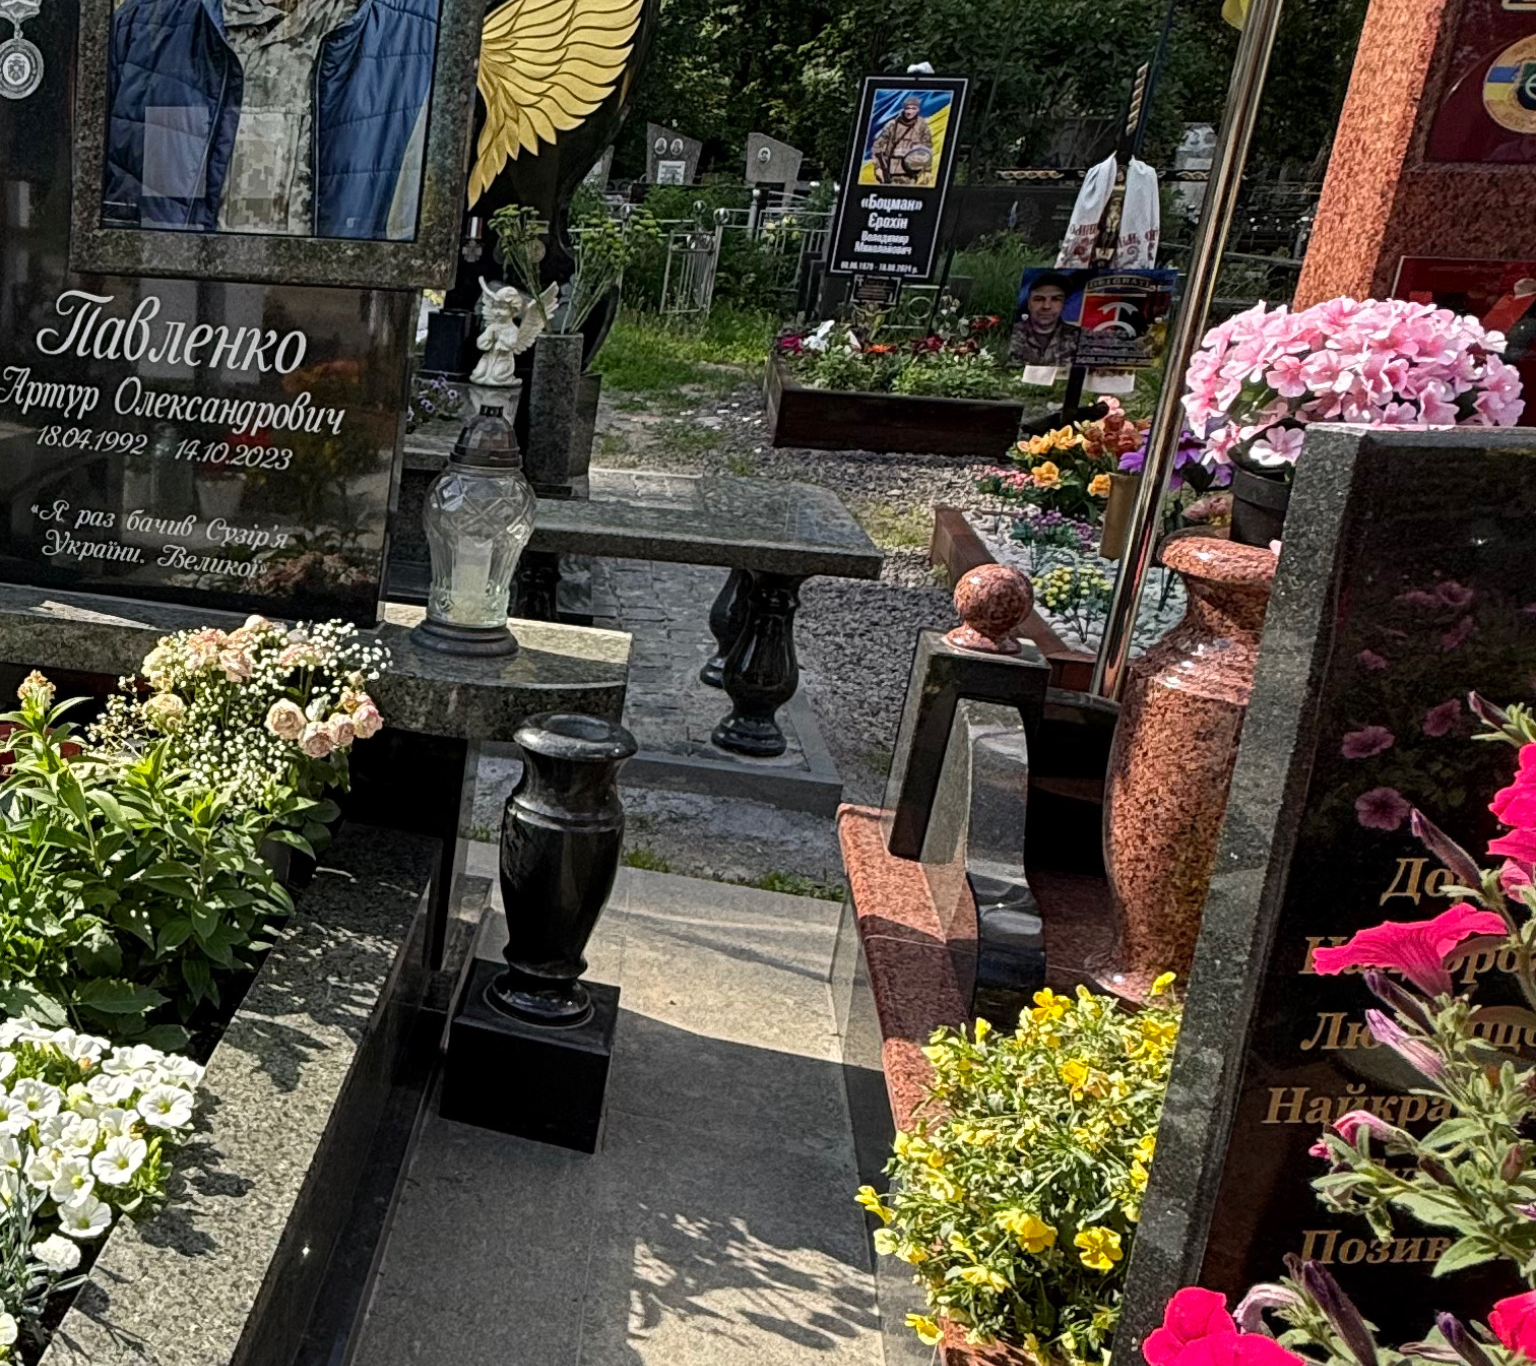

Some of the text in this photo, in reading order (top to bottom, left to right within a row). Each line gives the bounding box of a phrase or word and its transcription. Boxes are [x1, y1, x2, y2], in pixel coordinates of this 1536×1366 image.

[868, 212, 909, 231] Єрохін
[36, 290, 307, 374] Павленко
[114, 376, 346, 436] Олександрович
[36, 425, 148, 457] 18.04.1992
[175, 438, 294, 471] 14.10.2023
[75, 510, 115, 529] раз
[126, 506, 195, 537] бачив
[41, 530, 145, 565] України.
